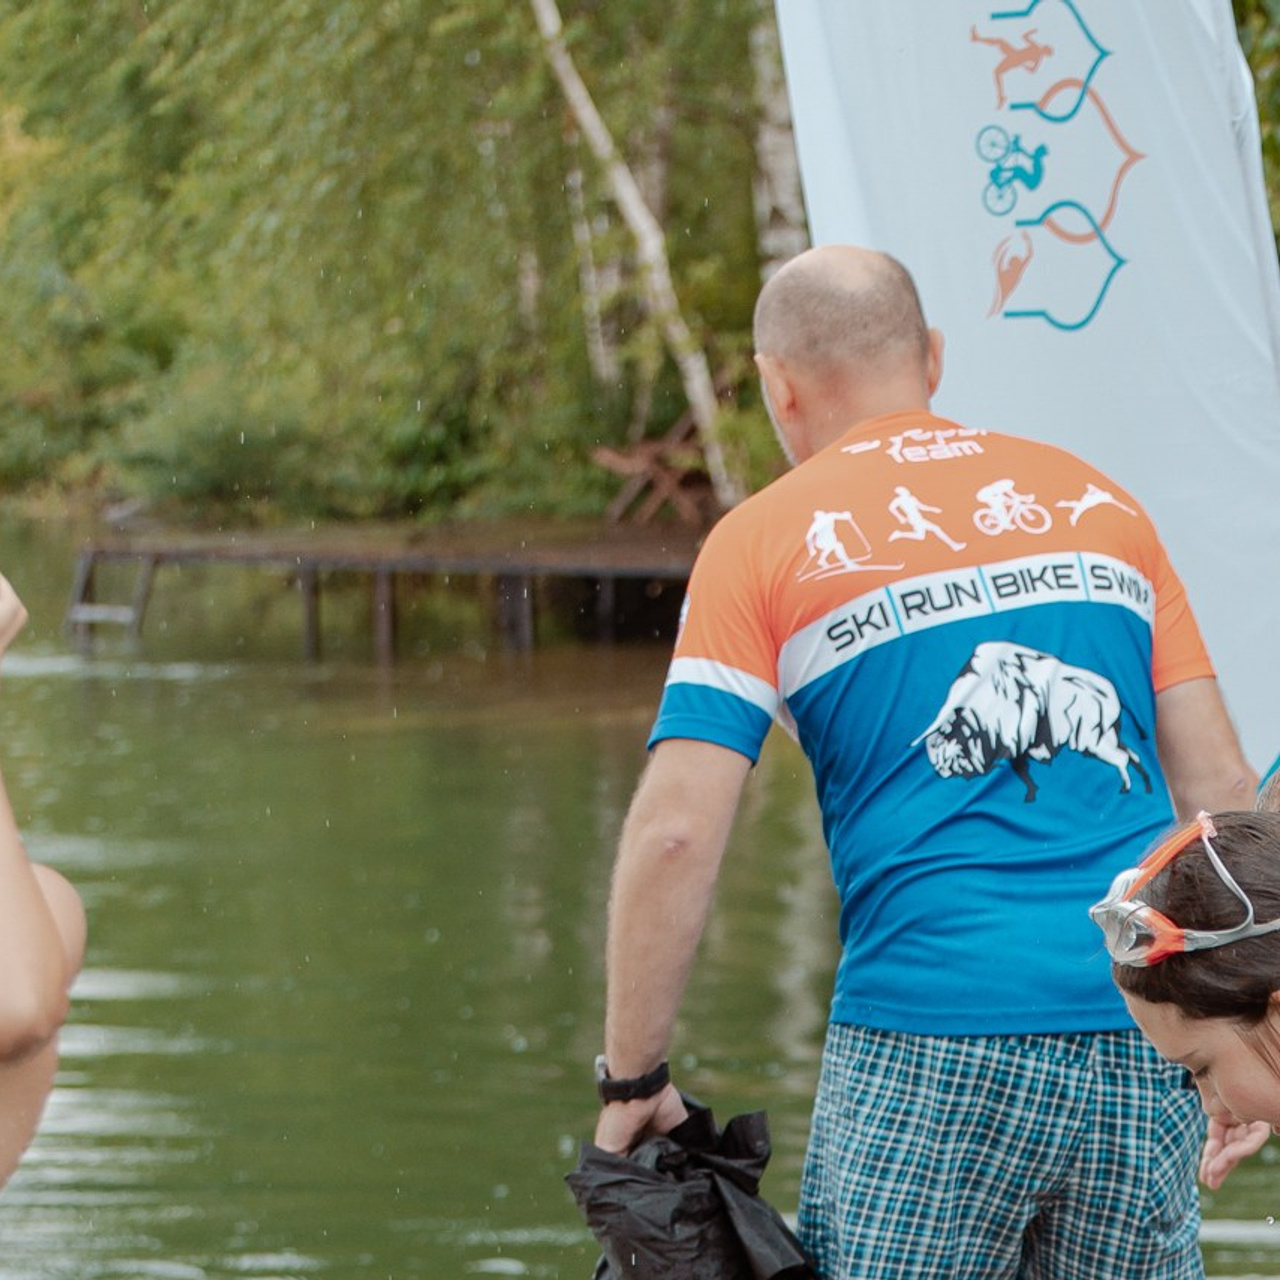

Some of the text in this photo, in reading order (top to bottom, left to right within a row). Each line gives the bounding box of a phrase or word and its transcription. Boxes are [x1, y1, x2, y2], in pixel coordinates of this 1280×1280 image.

[826, 600, 891, 652] SKI
[899, 579, 982, 620] RUN
[991, 564, 1078, 599] BIKE
